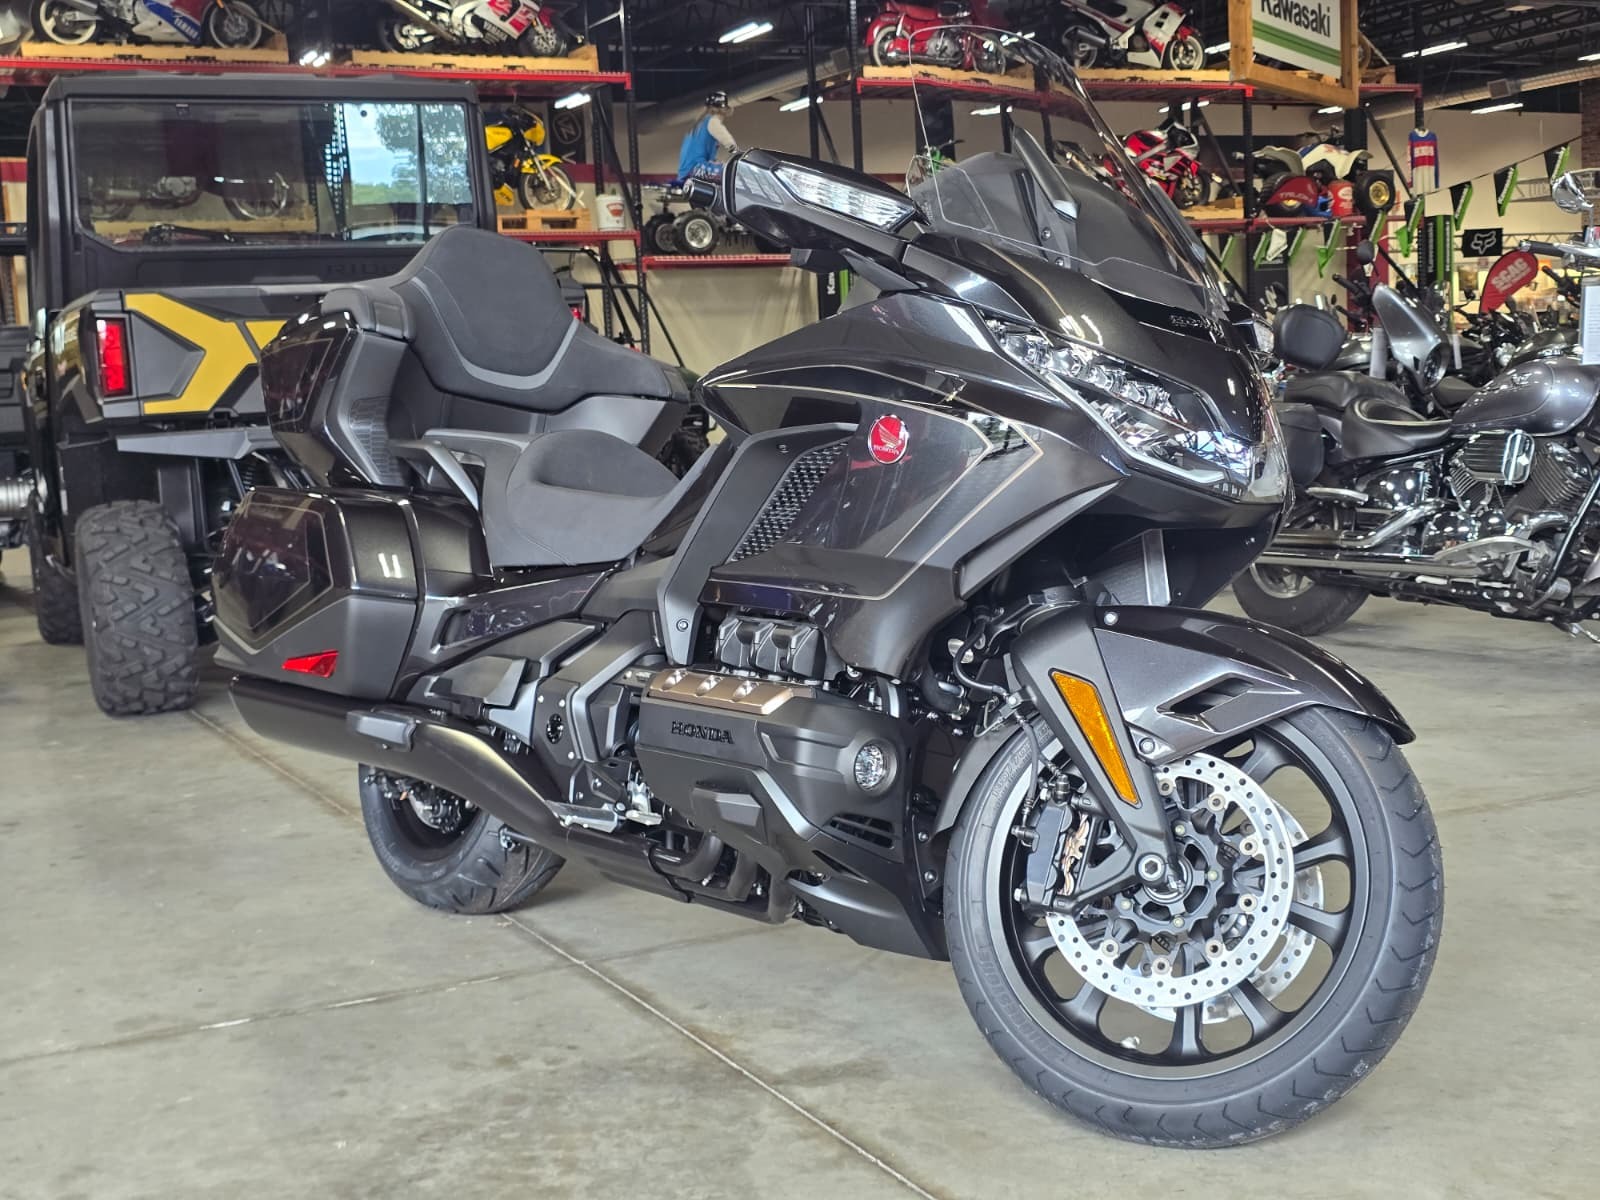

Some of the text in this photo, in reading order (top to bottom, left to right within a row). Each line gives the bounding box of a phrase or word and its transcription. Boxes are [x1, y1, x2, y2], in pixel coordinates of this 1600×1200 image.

[327, 263, 400, 274] RIDG
[1490, 256, 1529, 291] SCAG
[671, 720, 735, 745] HONDA
